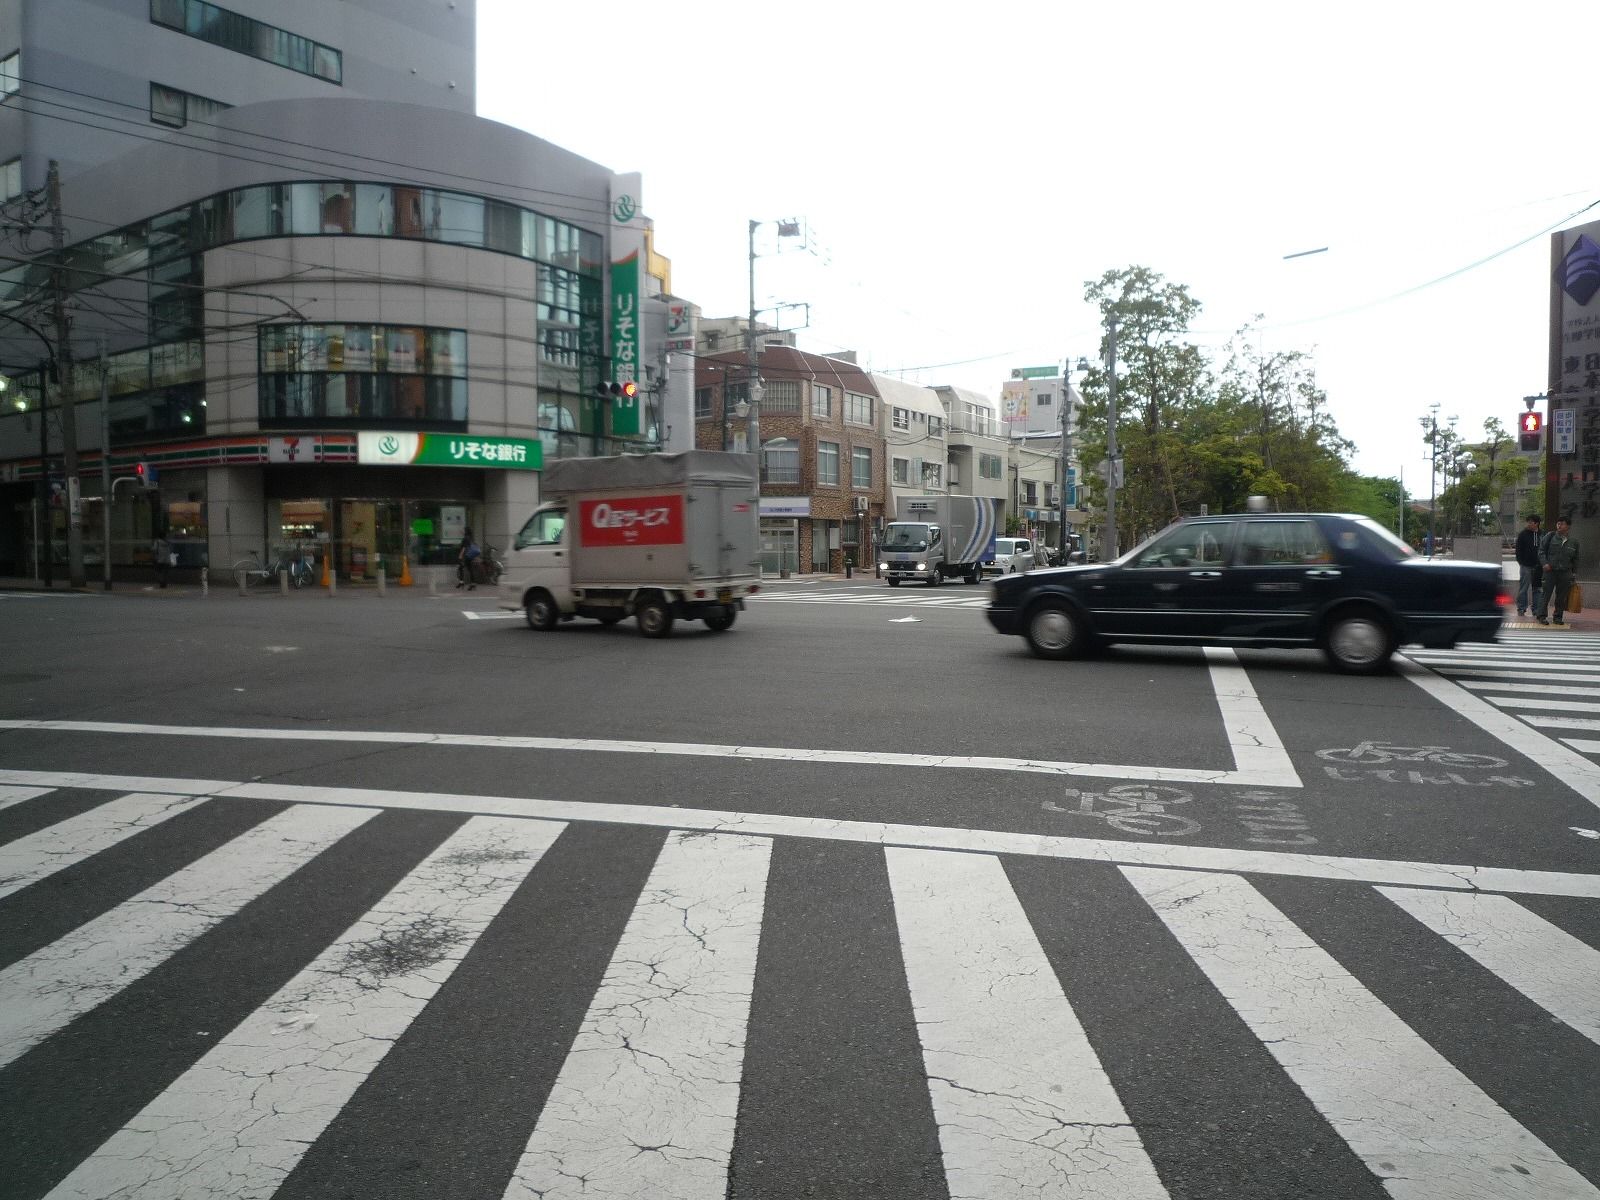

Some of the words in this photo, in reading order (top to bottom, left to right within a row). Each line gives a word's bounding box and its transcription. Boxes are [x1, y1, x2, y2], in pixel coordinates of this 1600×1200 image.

[450, 441, 527, 462] りそな銀行
